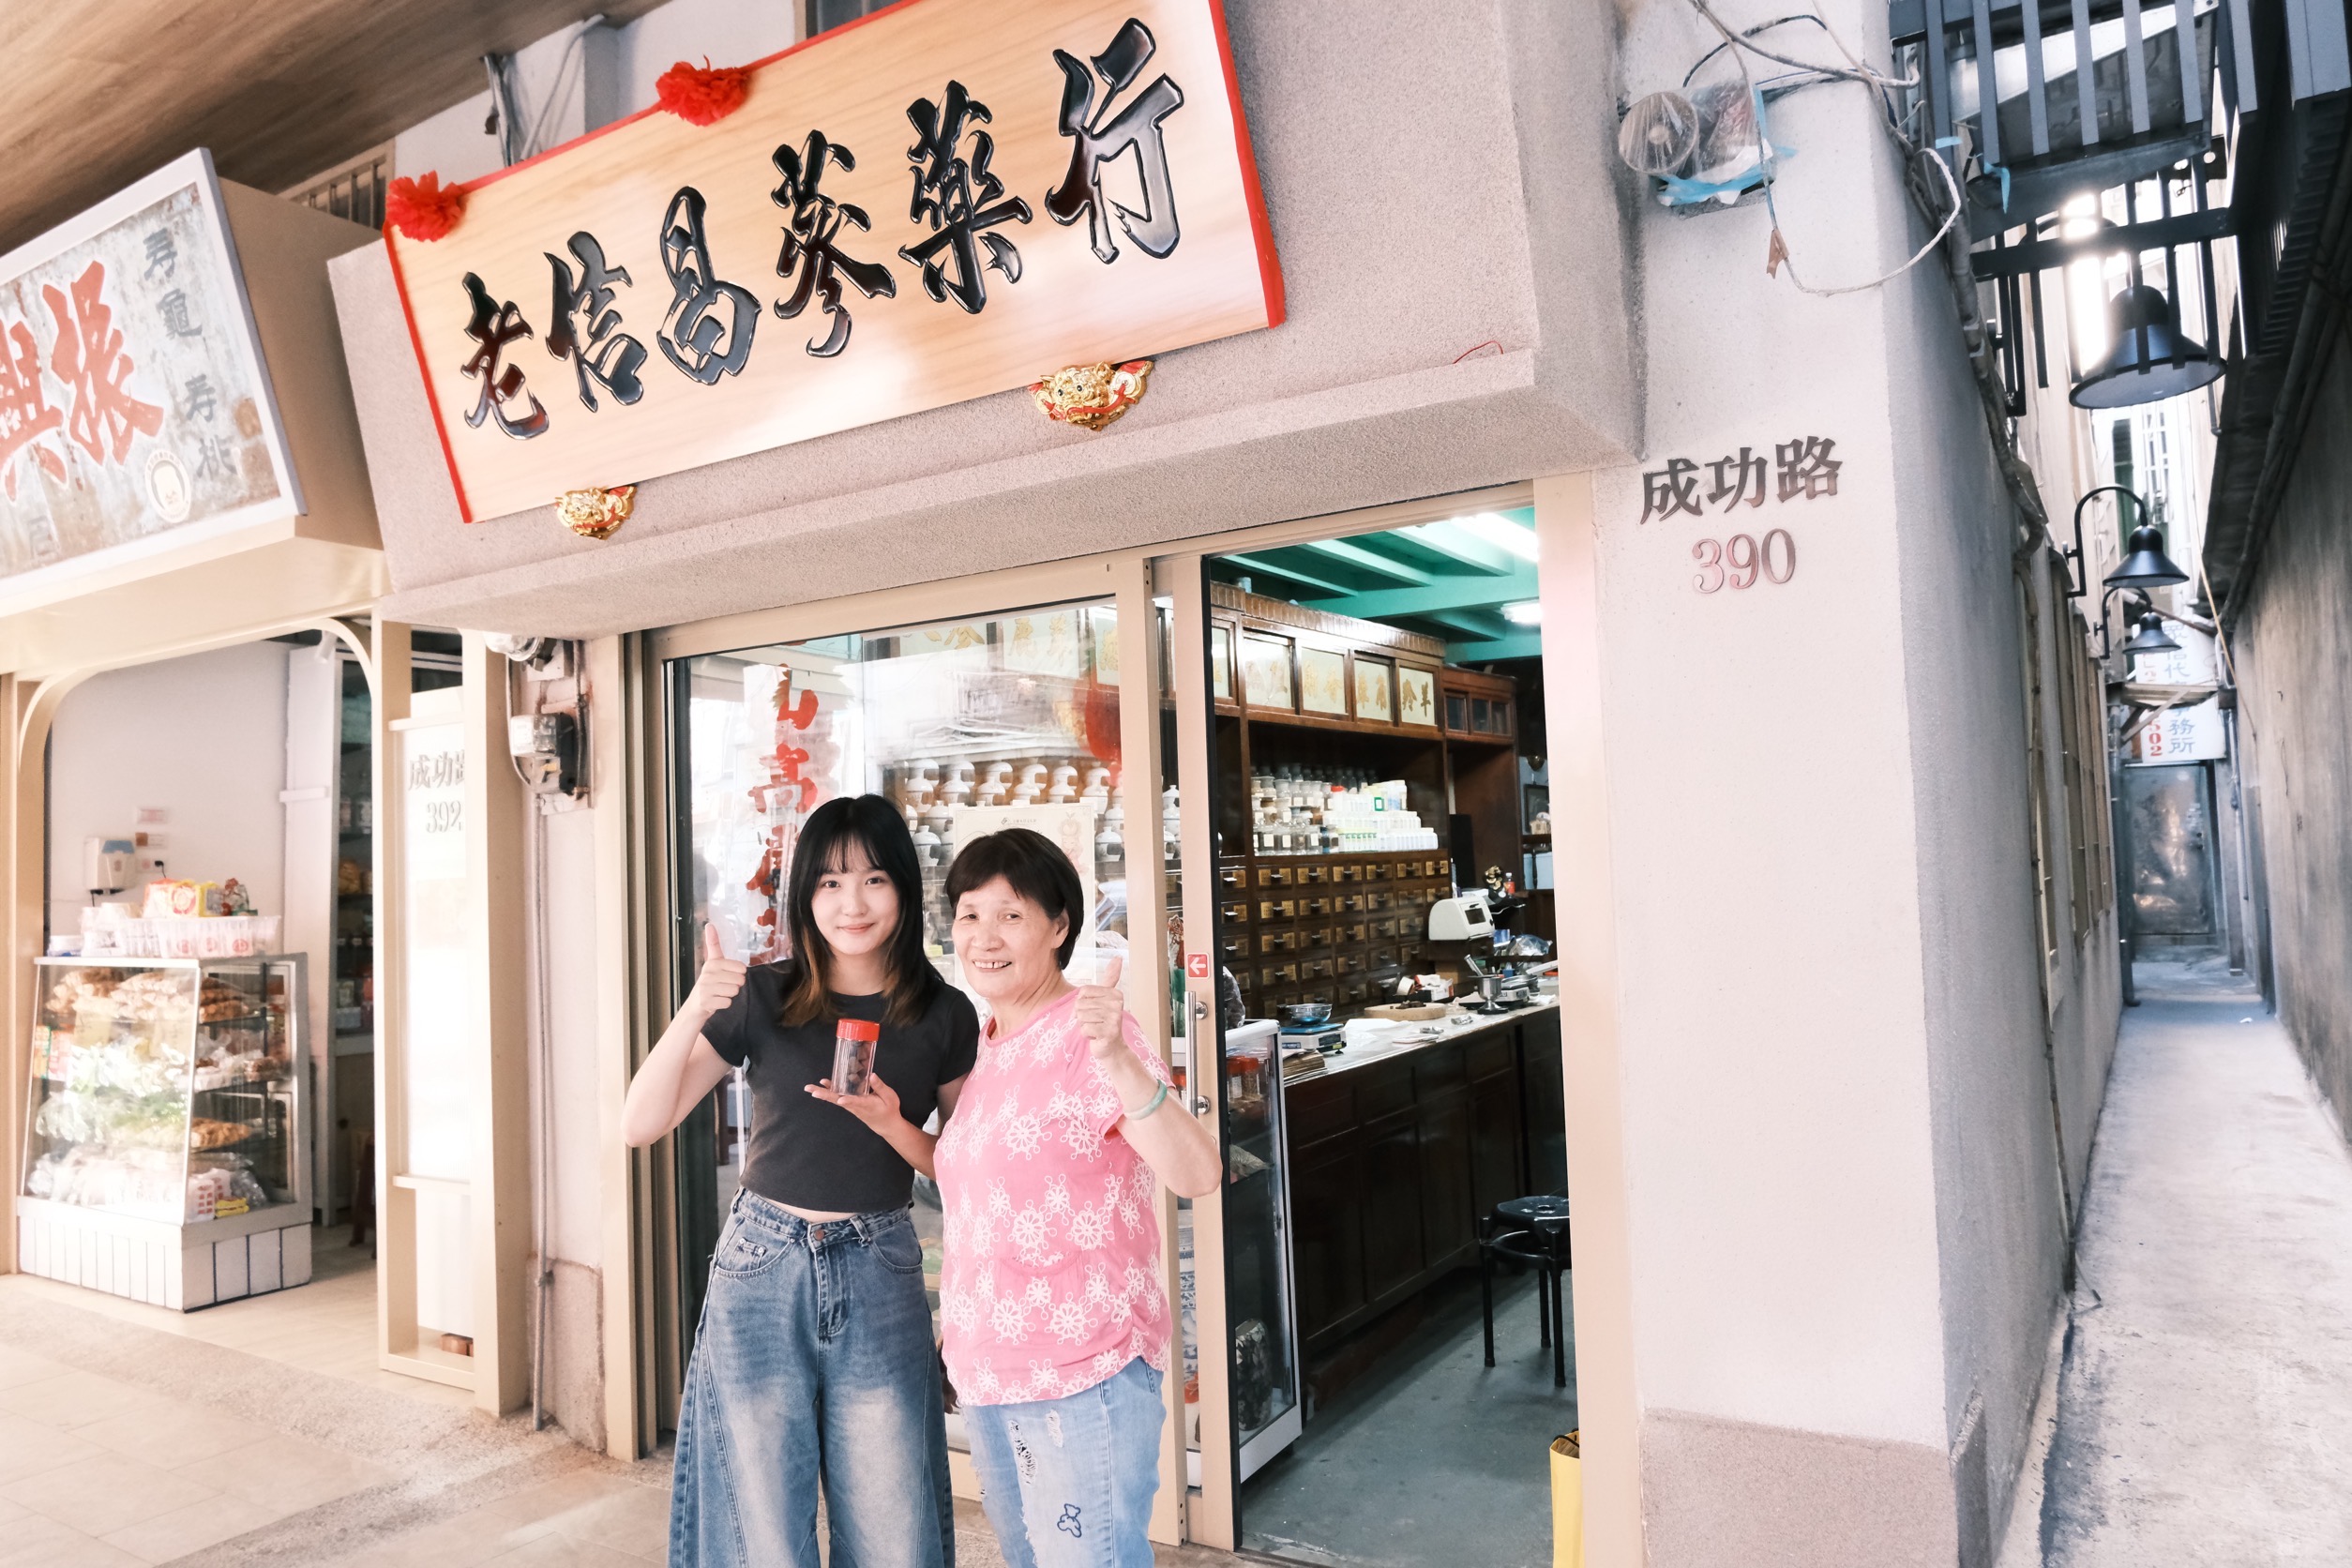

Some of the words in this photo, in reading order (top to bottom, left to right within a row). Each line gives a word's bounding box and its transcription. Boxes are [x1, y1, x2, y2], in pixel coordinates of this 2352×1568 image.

[1639, 435, 1844, 525] 成功路
[1691, 527, 1797, 594] 390
